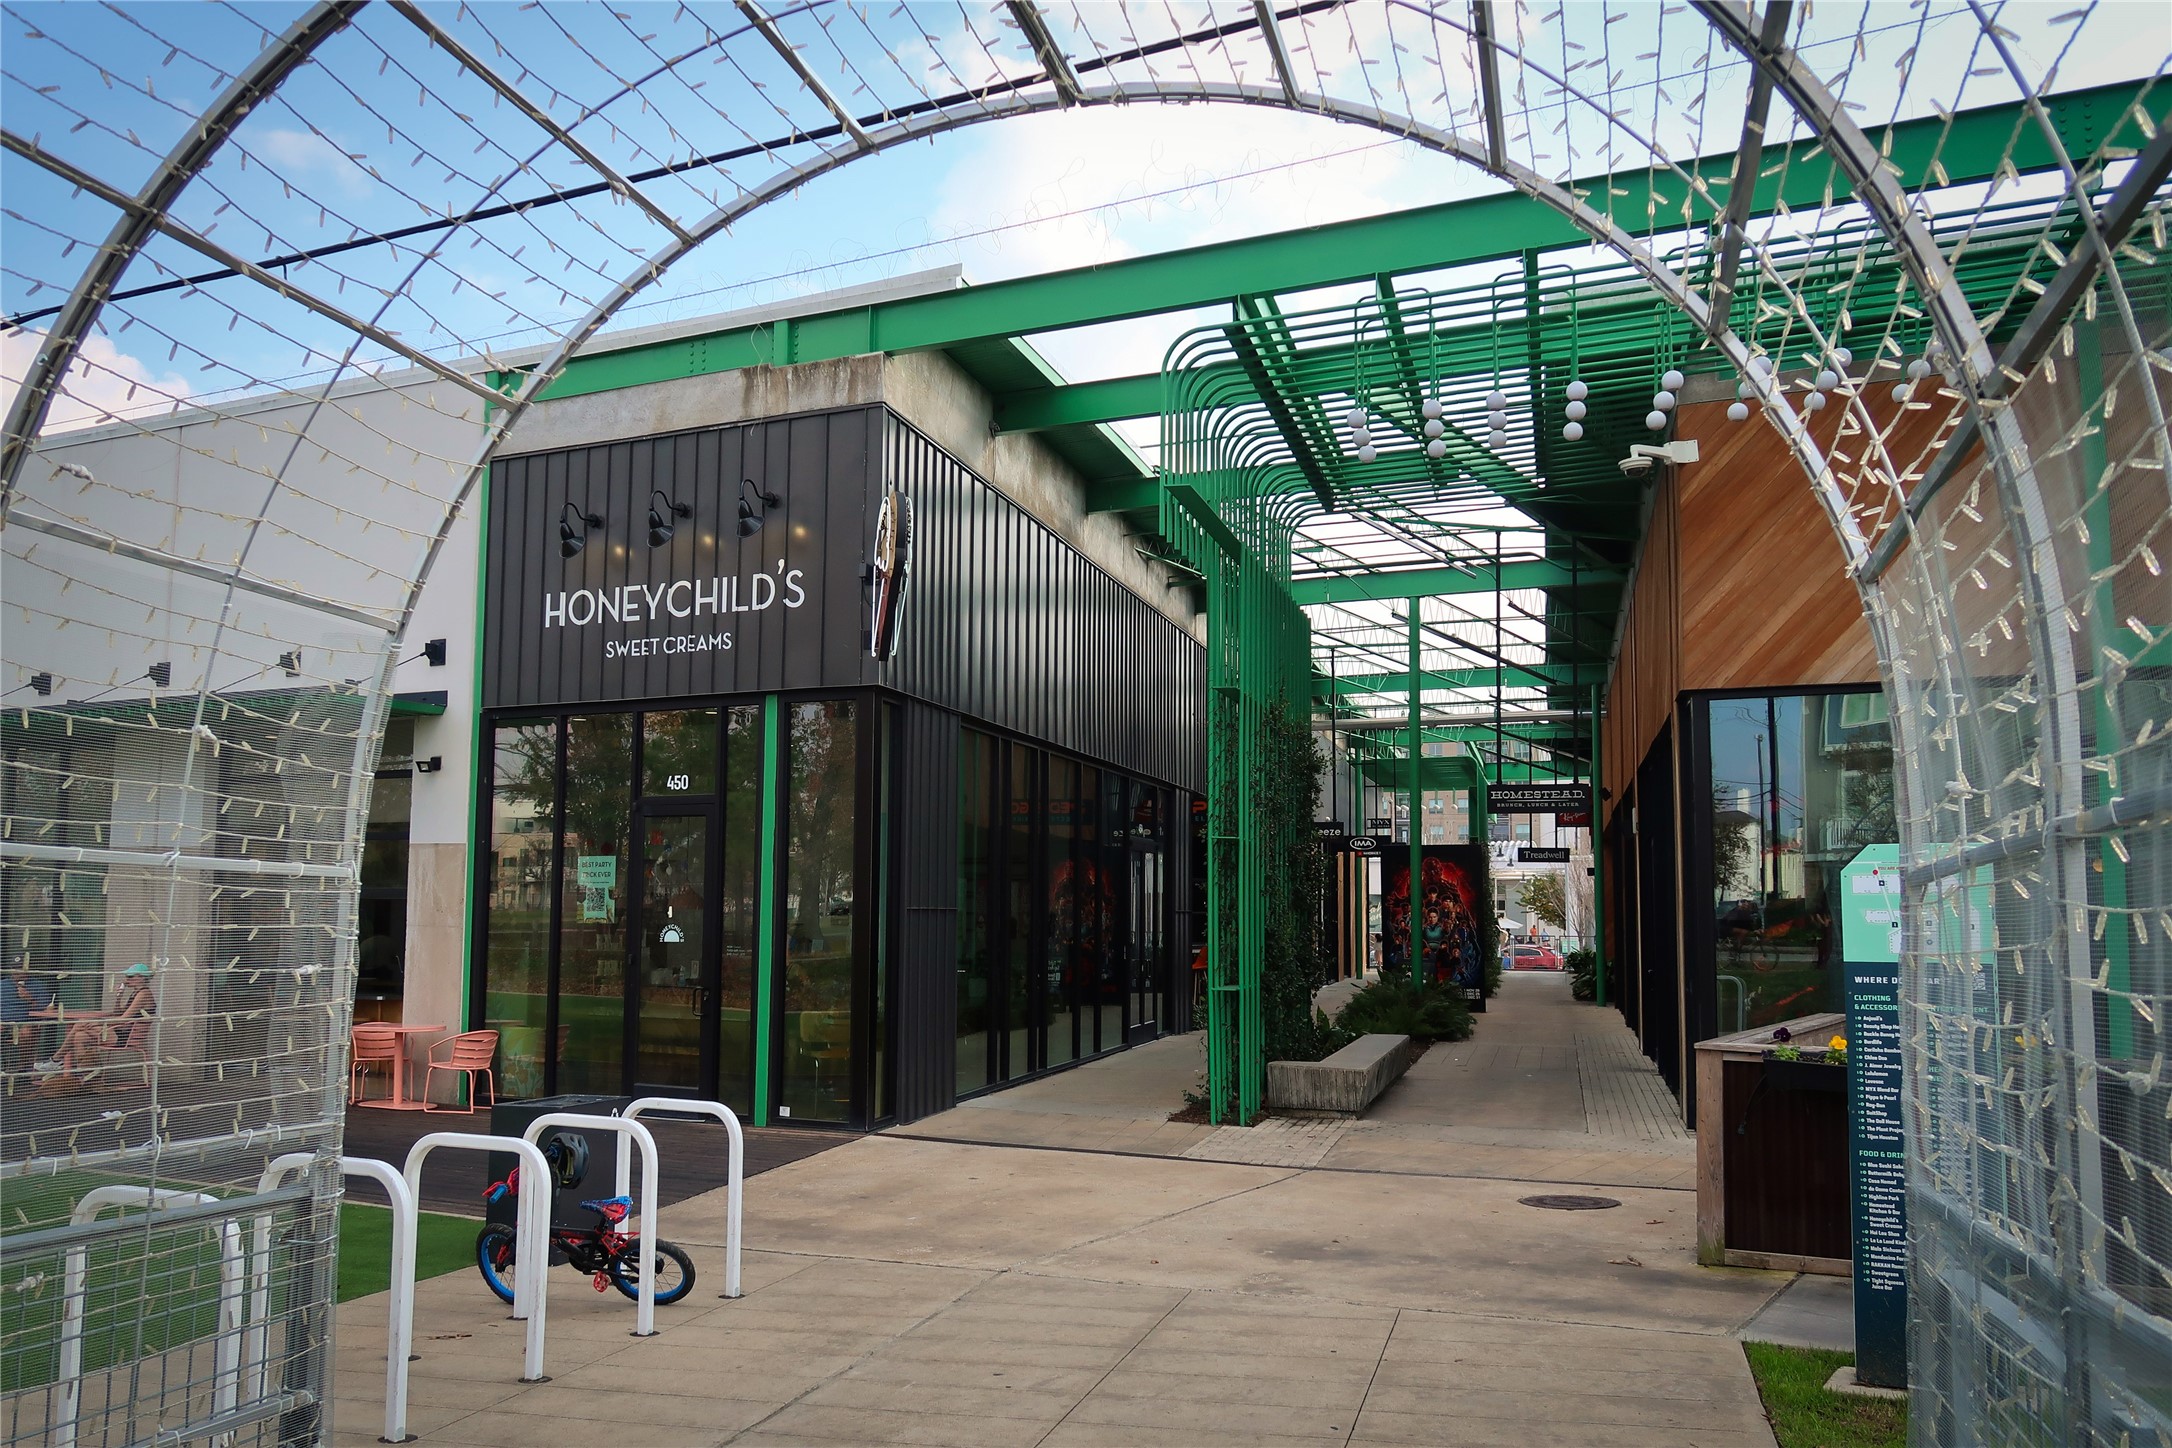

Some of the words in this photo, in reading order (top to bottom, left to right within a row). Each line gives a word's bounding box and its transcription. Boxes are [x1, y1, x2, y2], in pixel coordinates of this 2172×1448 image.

[545, 559, 806, 628] HONEYCHILD'S
[605, 638, 660, 659] SWEET
[663, 632, 732, 655] CREAMS
[667, 775, 689, 790] 450
[1524, 850, 1565, 859] Treadwell
[659, 924, 685, 943] HONEYCHILD'S
[1854, 976, 1889, 984] WHERE
[1886, 1151, 1905, 1159] DRIN
